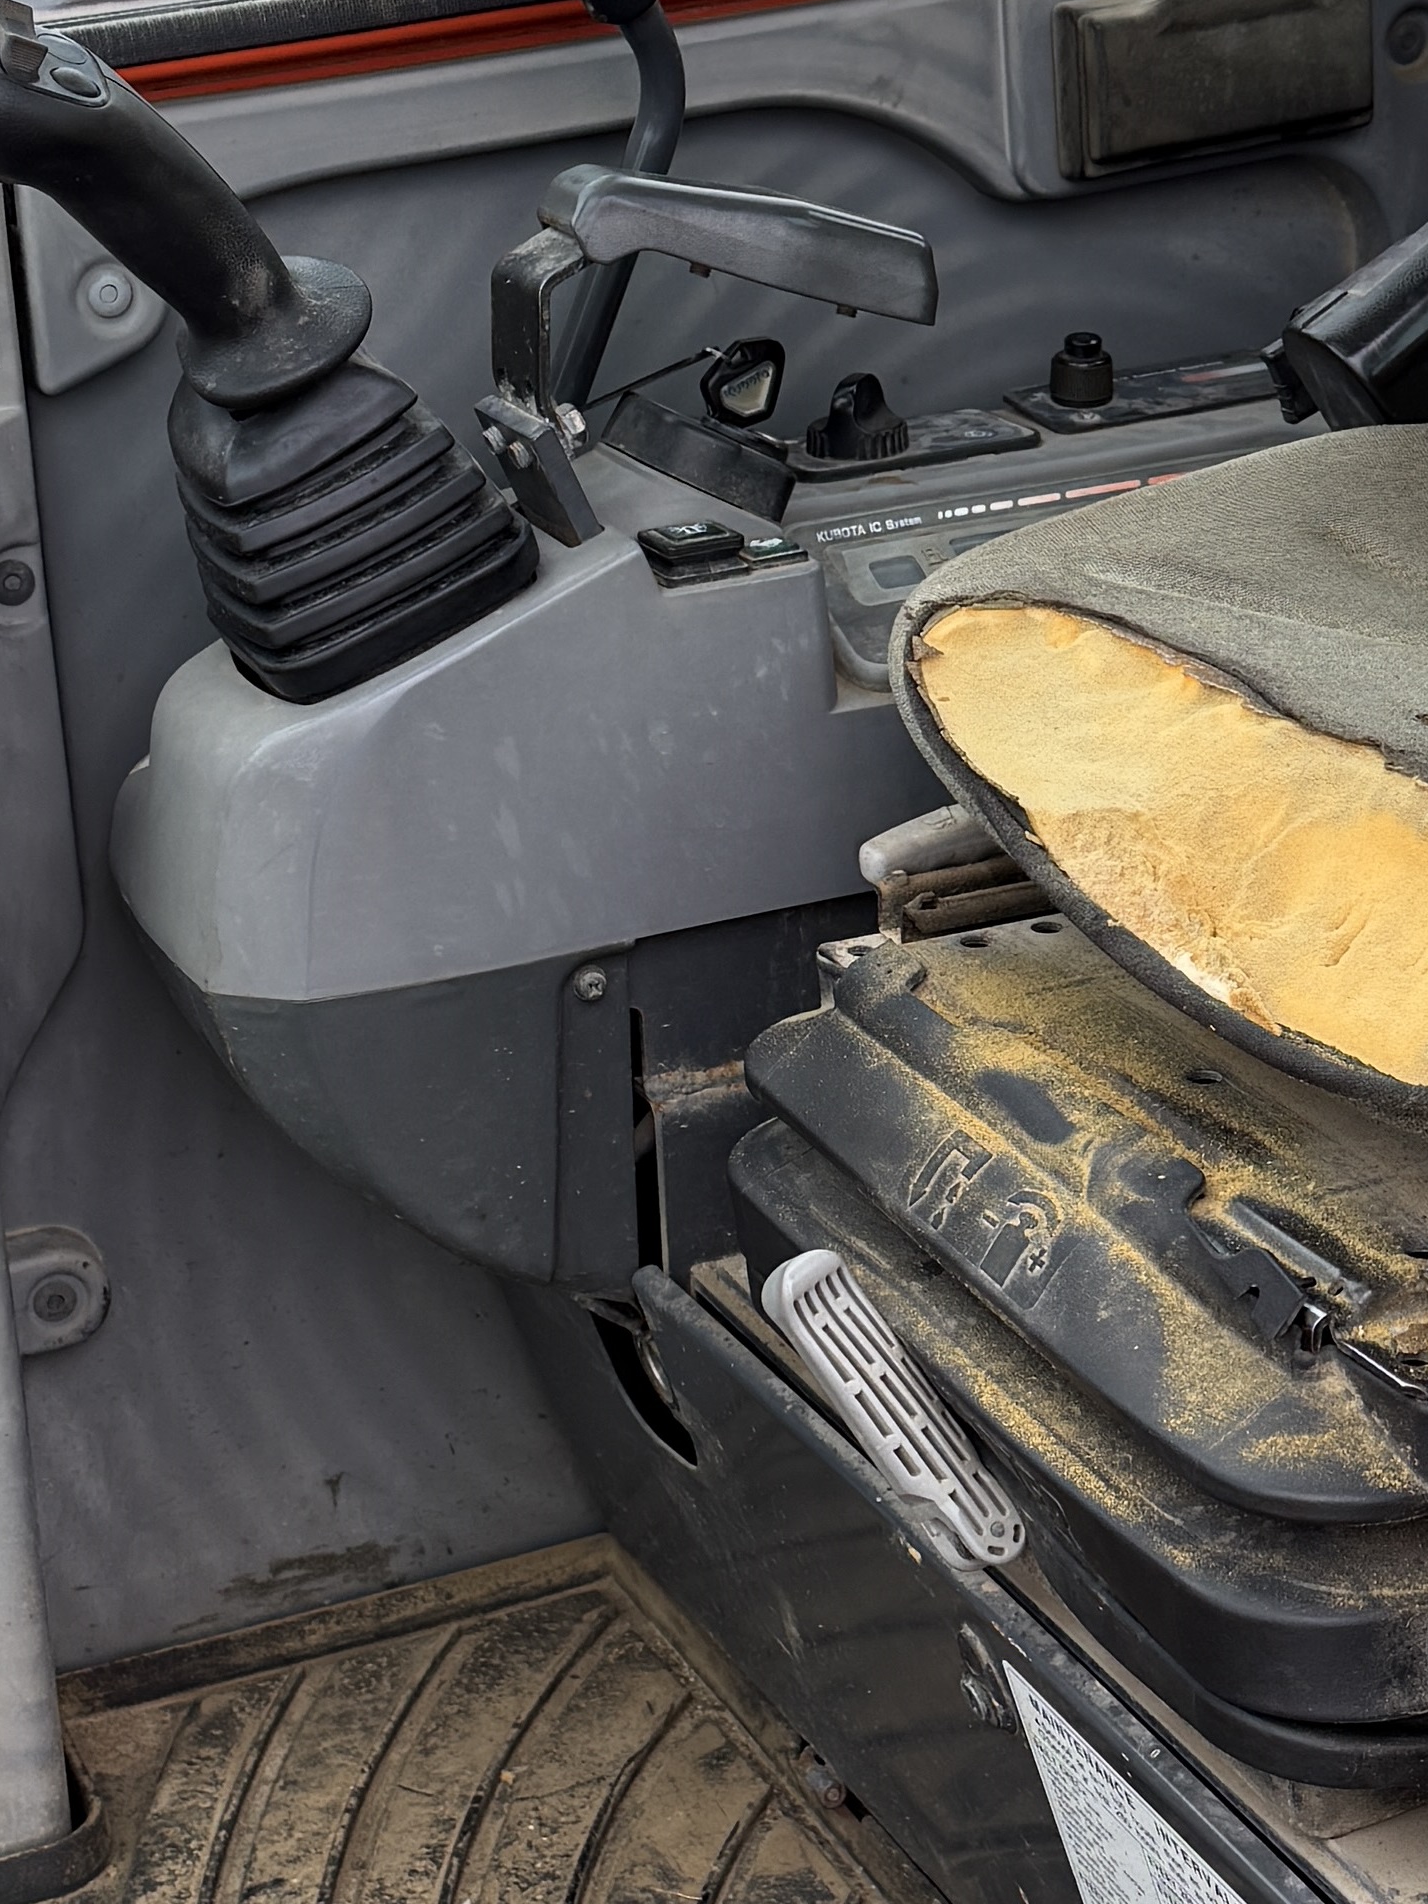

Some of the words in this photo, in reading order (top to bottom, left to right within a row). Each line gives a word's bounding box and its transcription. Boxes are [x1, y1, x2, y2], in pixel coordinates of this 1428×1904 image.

[816, 524, 866, 543] KUBOTA
[869, 521, 882, 533] IC
[885, 517, 922, 530] System
[1029, 1694, 1136, 1811] MAINTENANCE
